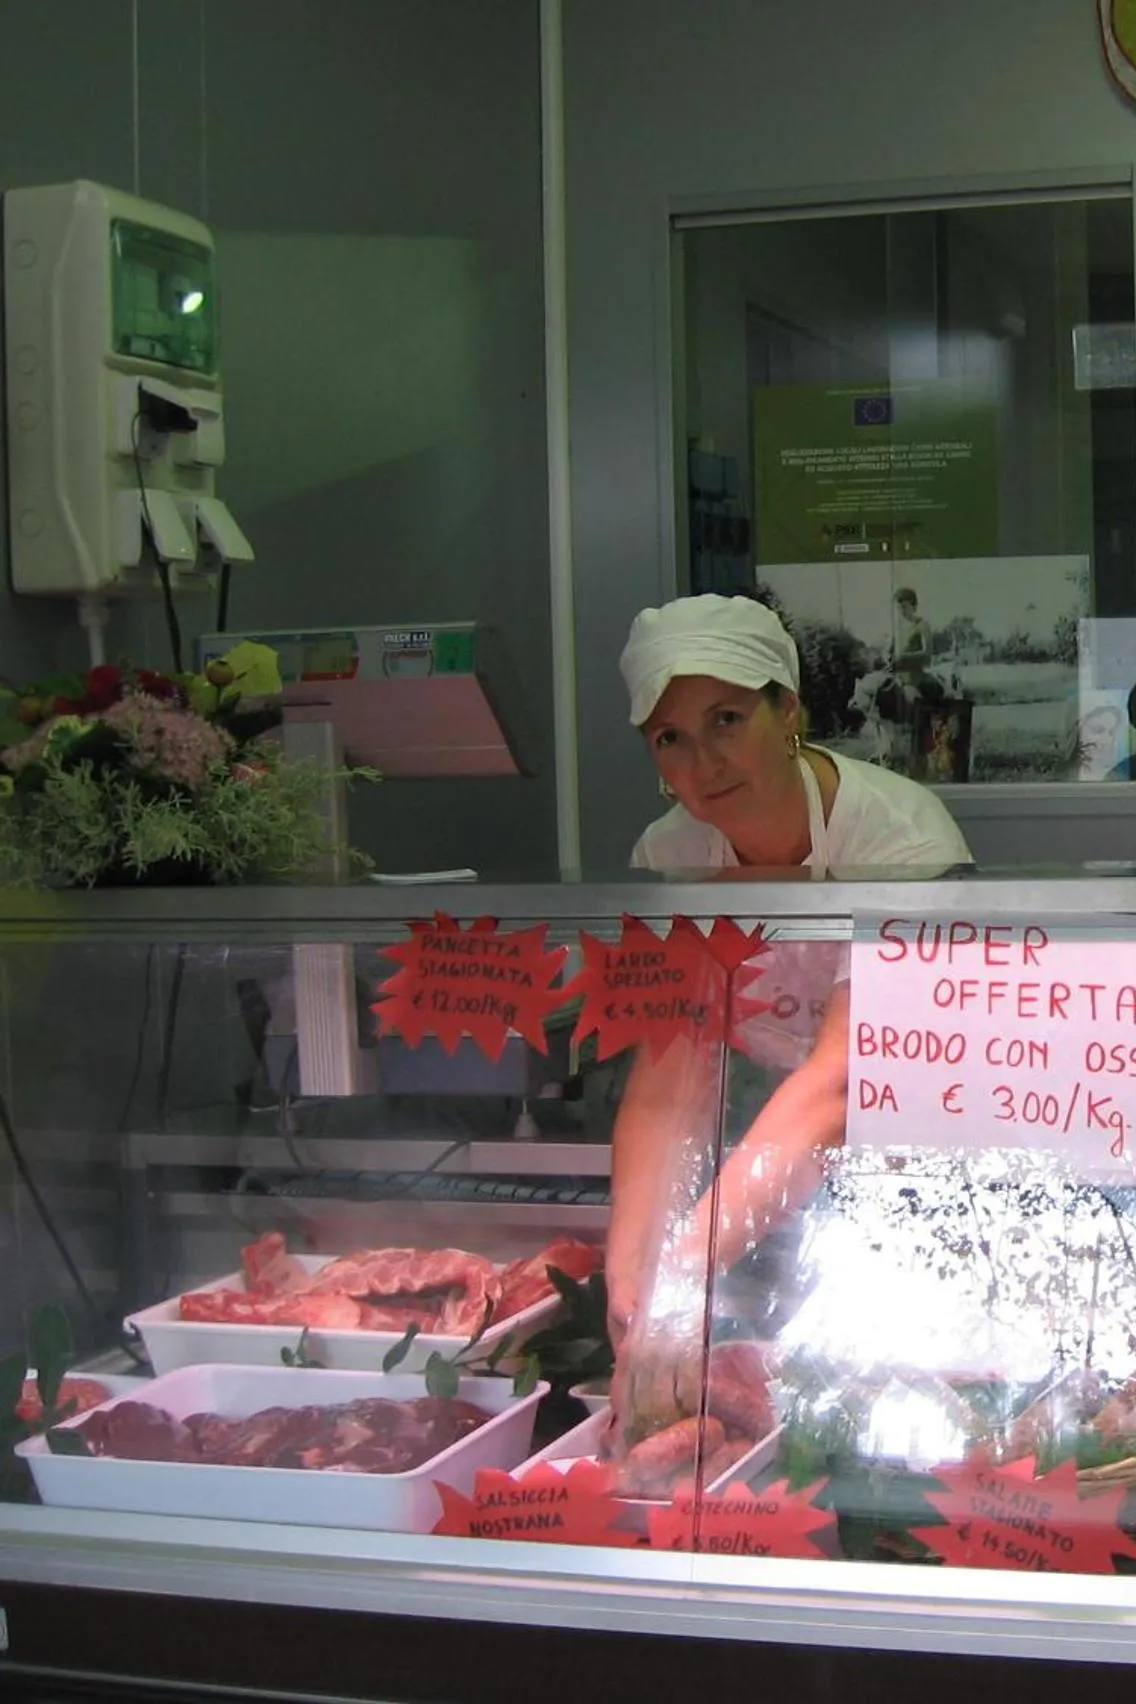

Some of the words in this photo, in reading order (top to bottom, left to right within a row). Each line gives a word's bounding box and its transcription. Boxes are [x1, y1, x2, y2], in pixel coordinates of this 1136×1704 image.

[421, 932, 521, 957] PANCETTA
[877, 917, 1049, 966] SUPER
[857, 1022, 967, 1065] BRODO
[984, 1037, 1049, 1071] CON
[858, 1078, 900, 1113] DA
[942, 1083, 965, 1115] €
[469, 1512, 564, 1537] NOSTRANA
